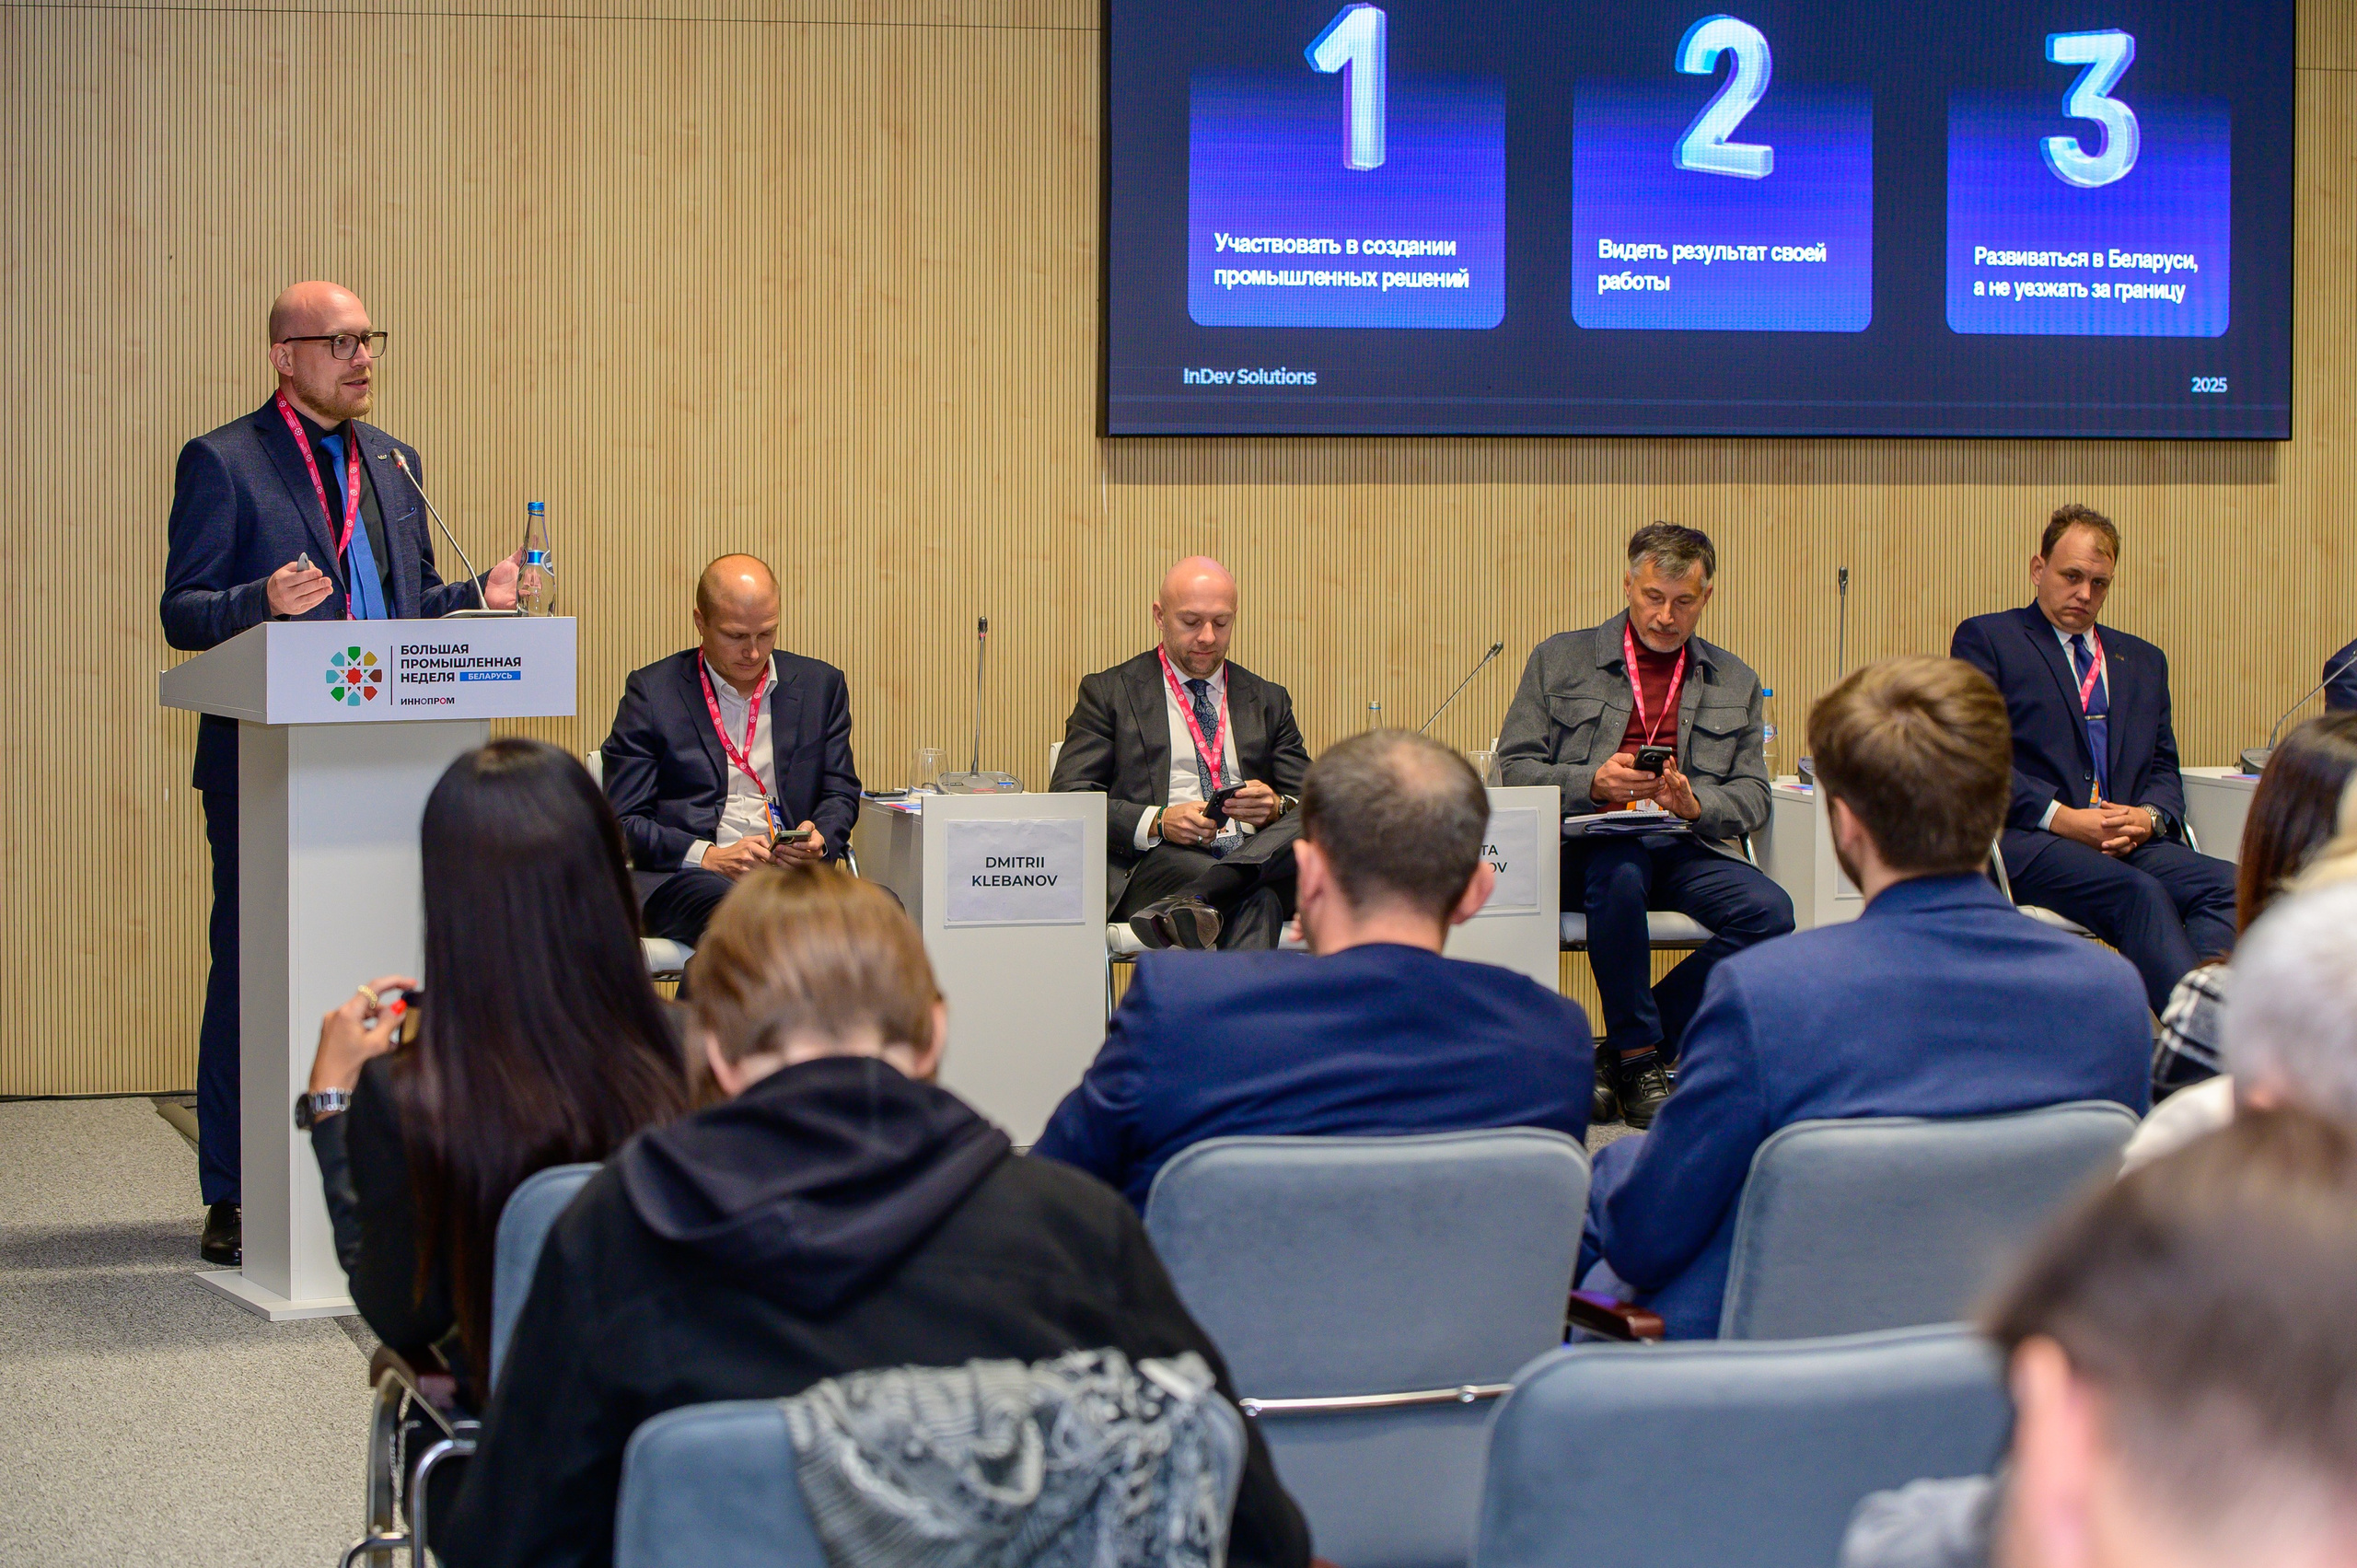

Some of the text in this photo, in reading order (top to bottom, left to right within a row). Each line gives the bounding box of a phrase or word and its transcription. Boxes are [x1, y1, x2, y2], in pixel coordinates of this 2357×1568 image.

[1304, 3, 1387, 172] 1
[1672, 14, 1774, 180] 2
[2039, 29, 2141, 189] 3
[1213, 232, 1457, 258] Участвовать в создании
[1598, 238, 1827, 265] Видеть результат своей
[1974, 246, 2199, 273] Развиваться в Беларуси,
[1213, 268, 1469, 292] промышленных решений
[1597, 271, 1670, 295] работы
[1973, 280, 2186, 304] а не уезжать за границу
[1183, 366, 1318, 386] InDev Solutions
[2191, 376, 2228, 393] 2025
[401, 644, 470, 656] БОЛЬШАЯ
[401, 656, 522, 669] ПРОМЫШЛЕННАЯ
[401, 672, 456, 684] НЕДЕЛЯ
[401, 697, 455, 705] ИННОПРОМ
[985, 856, 1045, 868] DMITRII
[971, 875, 1058, 887] KLEBANOV
